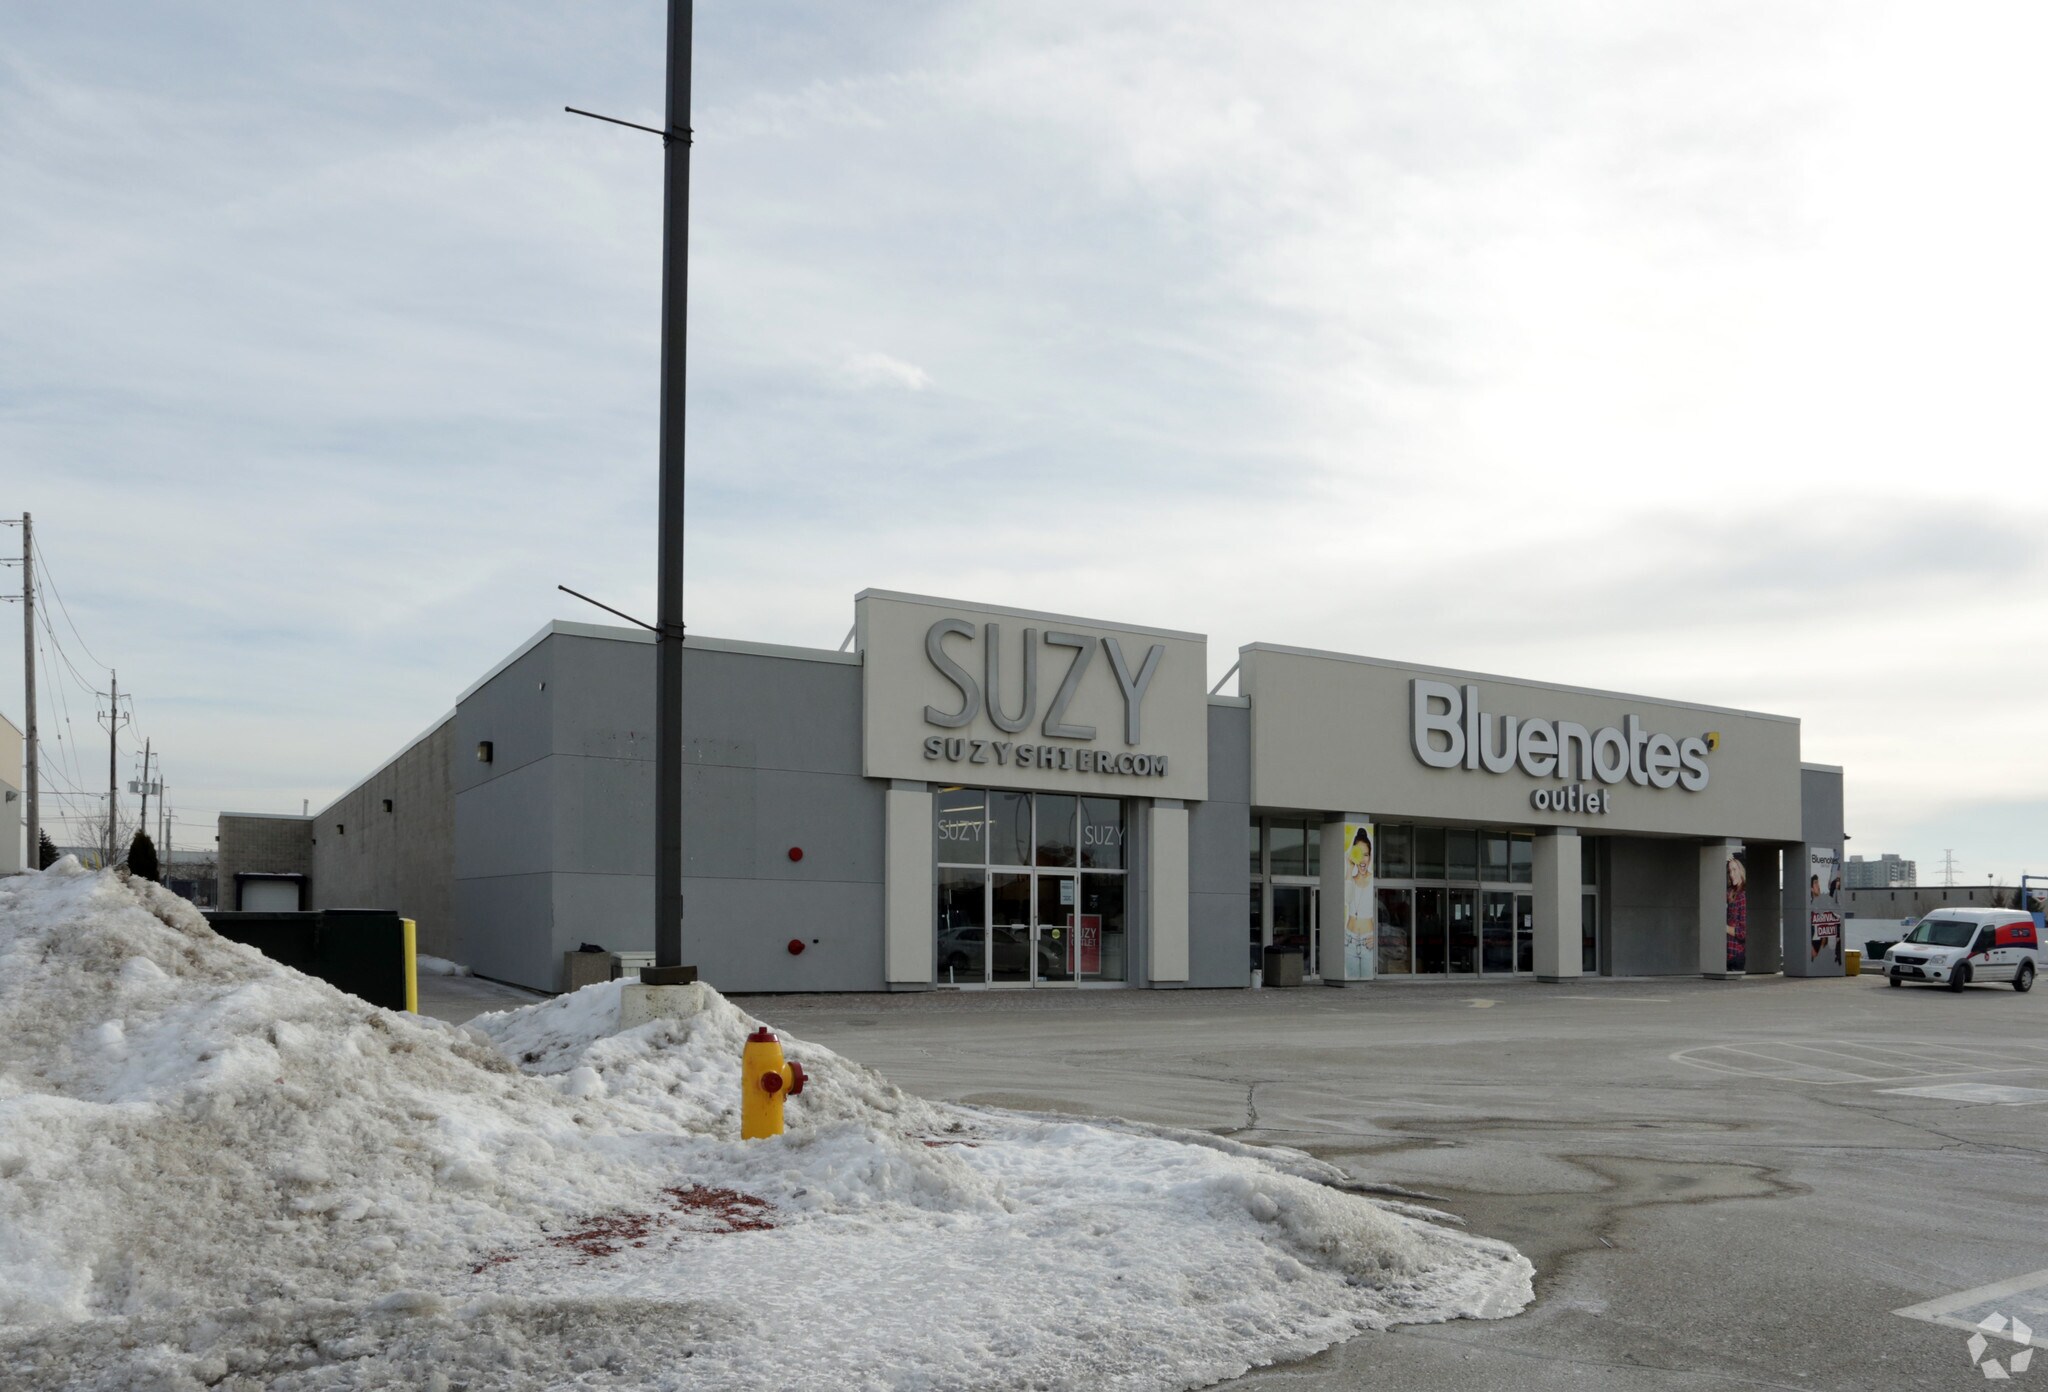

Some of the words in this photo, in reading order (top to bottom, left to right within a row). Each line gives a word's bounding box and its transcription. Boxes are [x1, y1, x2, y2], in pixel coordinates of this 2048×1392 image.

[923, 617, 1166, 746] SUZY
[1409, 678, 1710, 792] Bluenotes
[923, 735, 1169, 777] SUZYSHIER.COM
[1530, 783, 1611, 815] outlet
[937, 819, 983, 842] SUZY
[1084, 825, 1126, 846] SUZY
